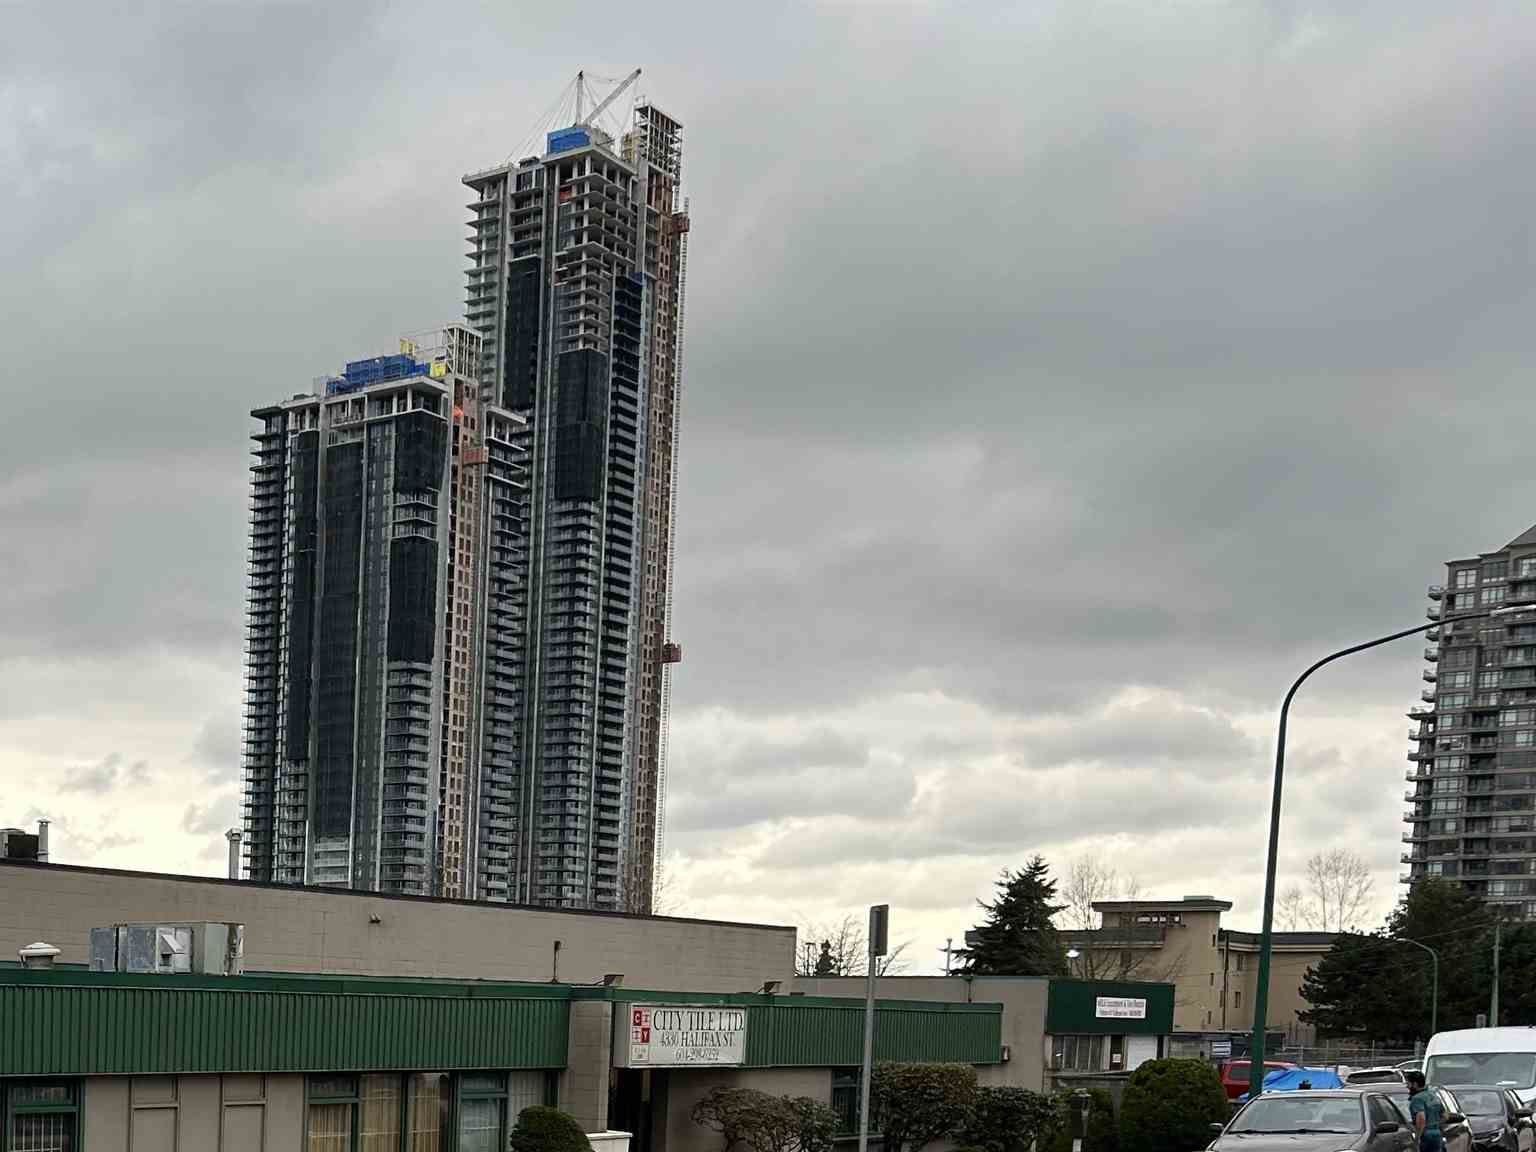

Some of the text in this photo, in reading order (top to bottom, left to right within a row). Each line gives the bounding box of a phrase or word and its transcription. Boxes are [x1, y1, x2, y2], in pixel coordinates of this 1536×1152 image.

[653, 1010, 744, 1031] CITY TILE LTD.
[680, 1031, 721, 1047] HALIFAX
